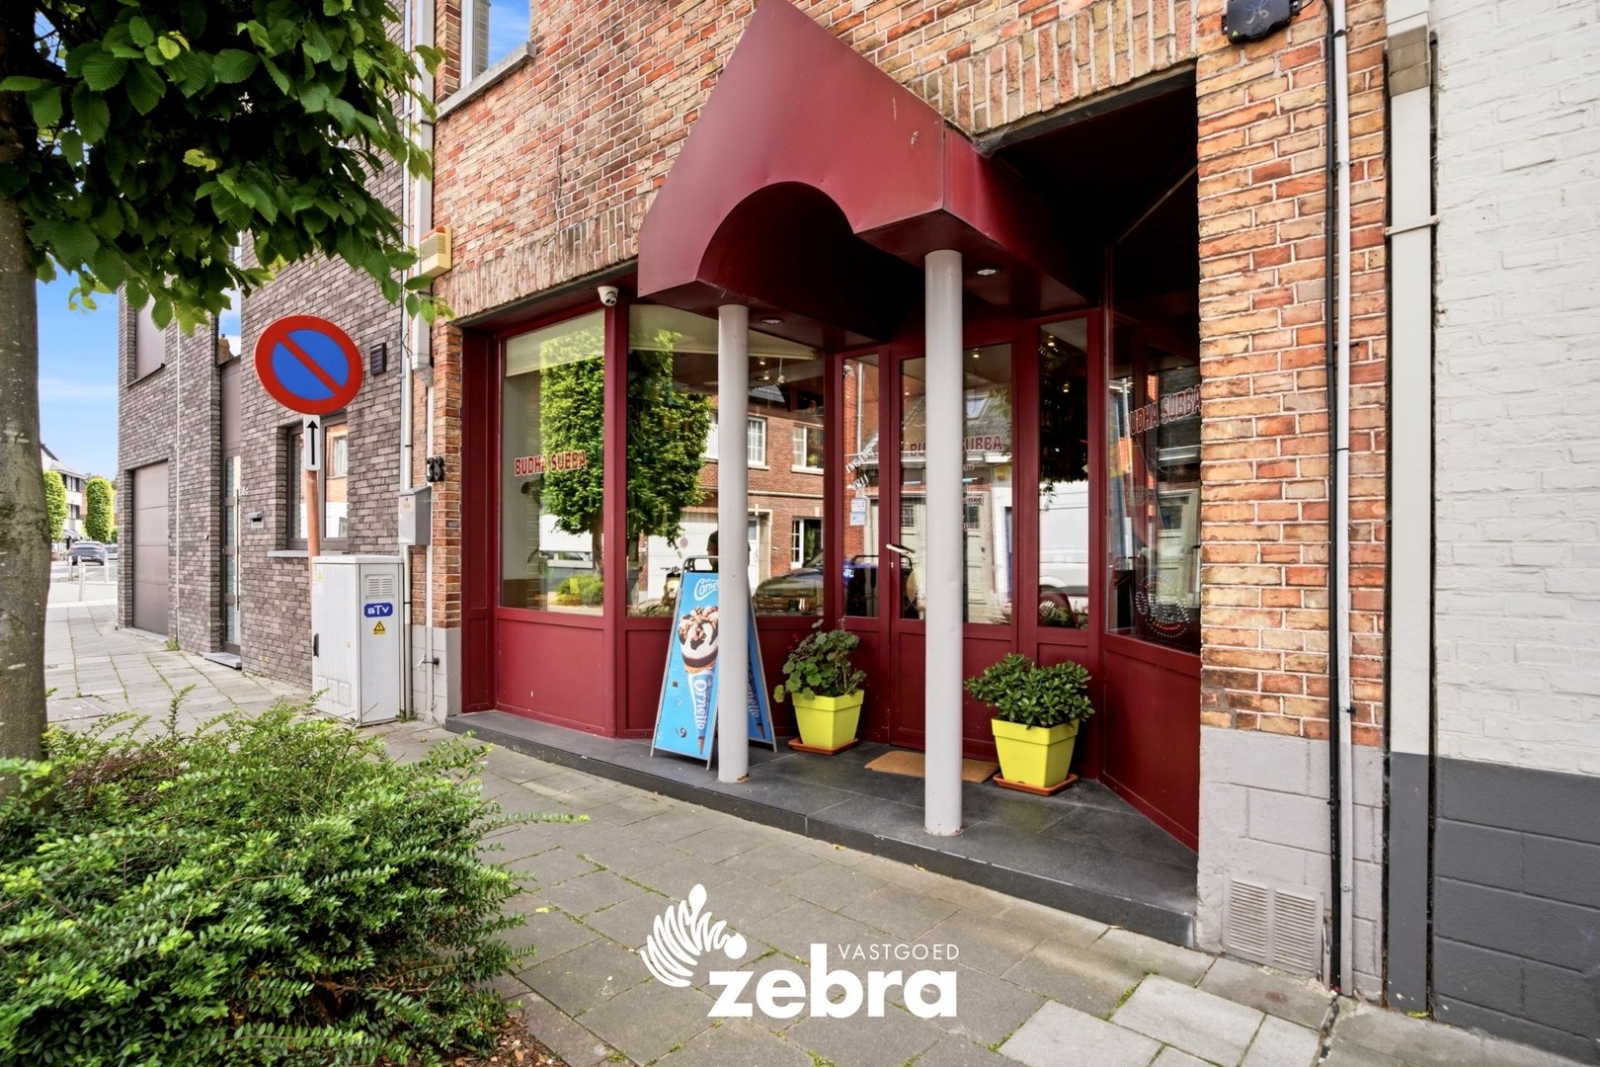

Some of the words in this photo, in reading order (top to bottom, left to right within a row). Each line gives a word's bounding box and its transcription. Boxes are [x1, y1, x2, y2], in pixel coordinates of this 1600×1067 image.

[1125, 402, 1160, 436] UDHA
[514, 454, 547, 476] BUDHA
[551, 449, 588, 472] SUBBA
[694, 578, 719, 601] Corne
[367, 604, 390, 616] BTV
